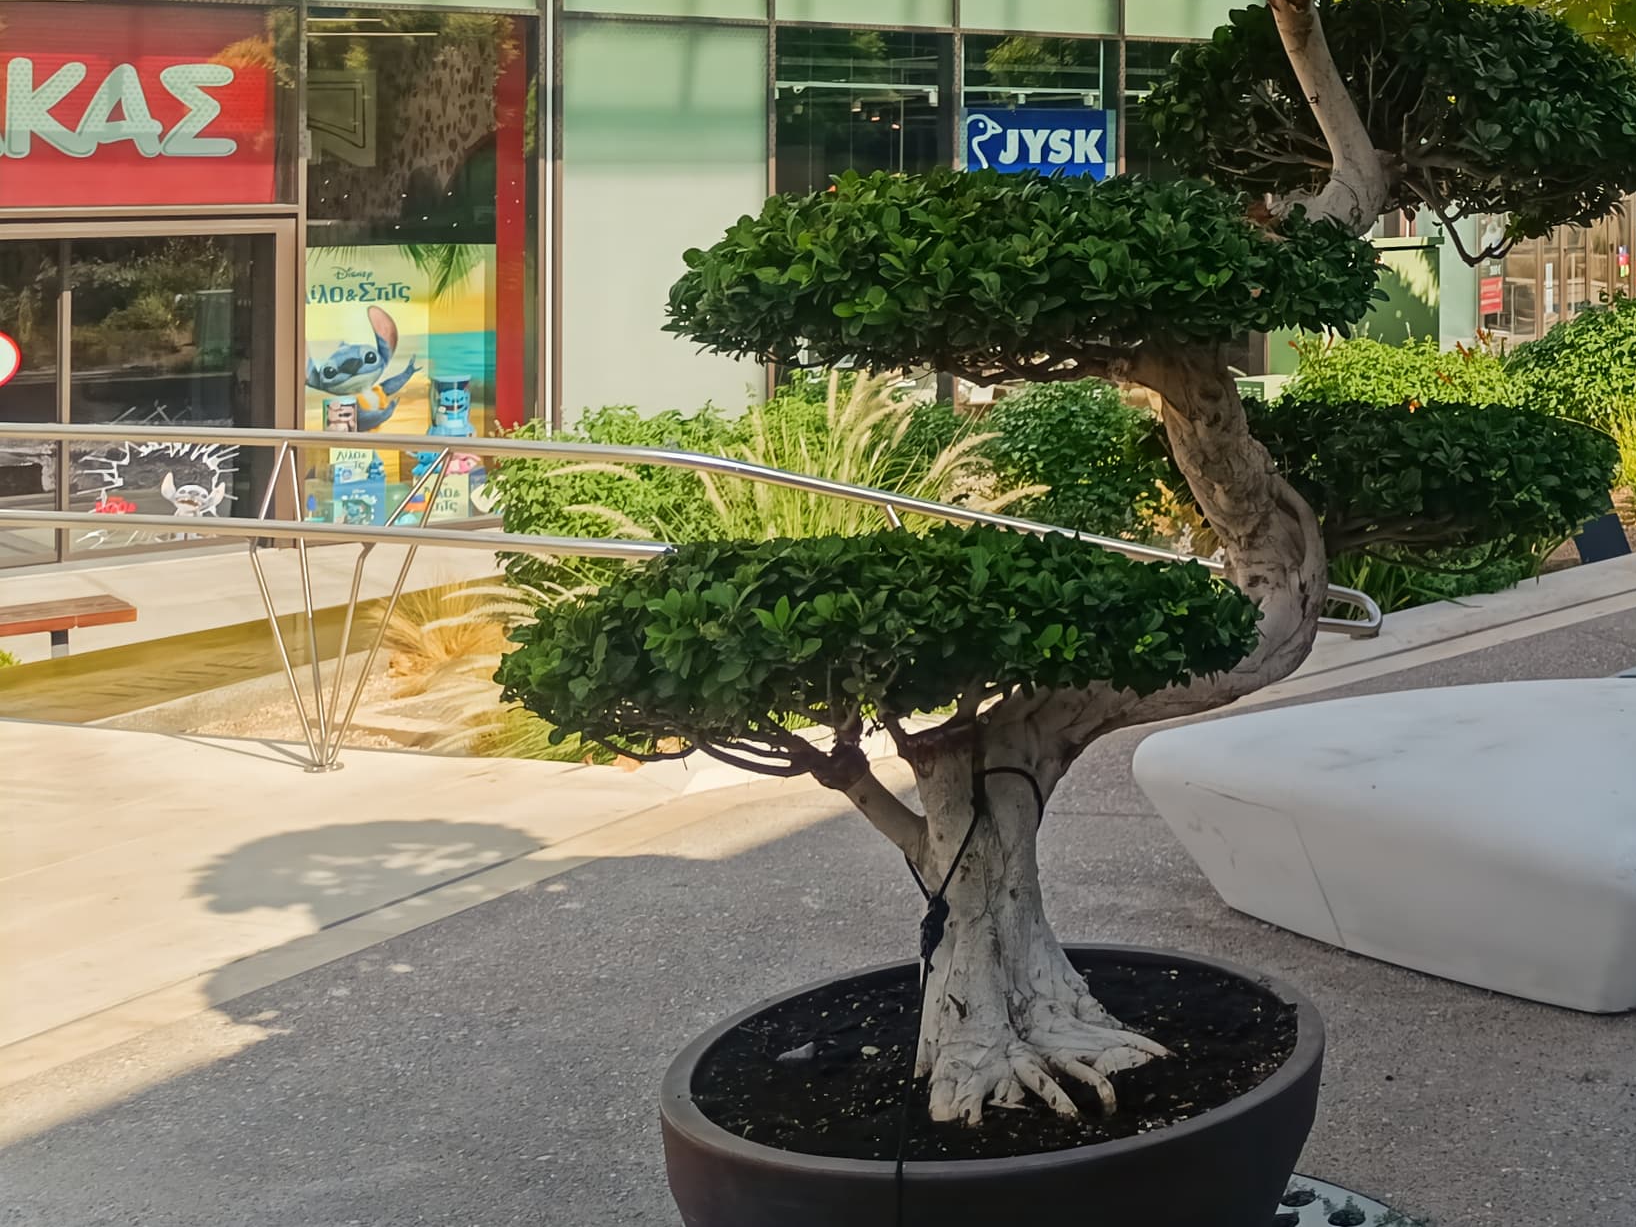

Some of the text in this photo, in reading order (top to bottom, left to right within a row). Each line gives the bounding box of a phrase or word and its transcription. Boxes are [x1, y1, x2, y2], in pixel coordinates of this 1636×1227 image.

[0, 57, 237, 158] ΚΑΣ
[998, 129, 1103, 164] JYSK
[331, 266, 373, 281] Disney
